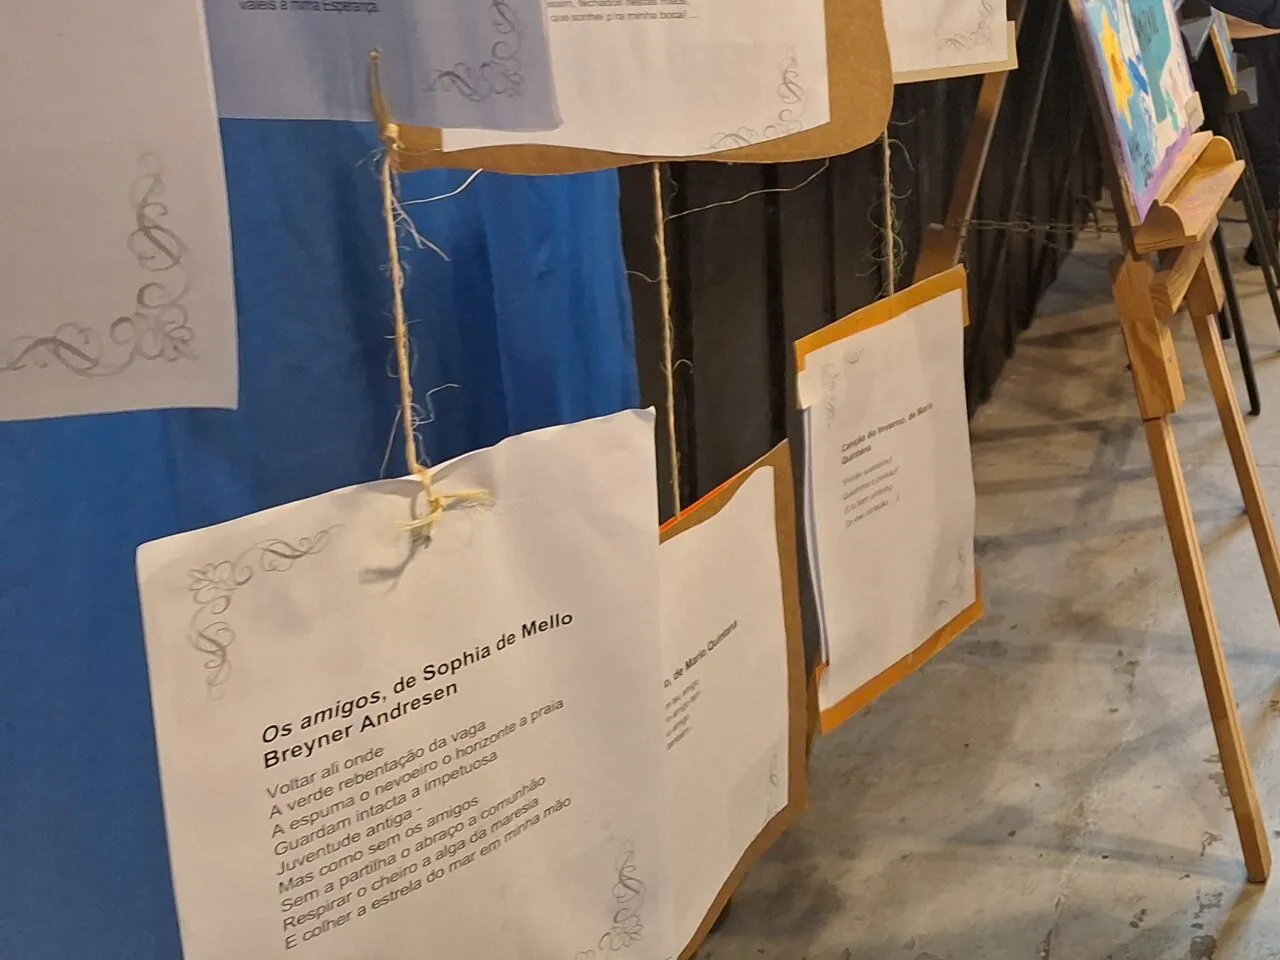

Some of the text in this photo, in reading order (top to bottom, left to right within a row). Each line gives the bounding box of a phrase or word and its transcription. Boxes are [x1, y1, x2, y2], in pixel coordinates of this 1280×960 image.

[263, 613, 572, 743] Os amigos, de Sophia de Mello
[264, 684, 457, 768] Breyner Andresen
[266, 748, 384, 798] Voltar ali onde
[269, 722, 486, 819] A verde rebentação da vaga
[272, 700, 564, 838] A espuma o nevoeiro o horizonte a praia
[274, 752, 497, 855] Guardam intacta a impetuosa
[277, 810, 412, 876] Juventude antiga
[279, 797, 479, 894] Mas como sem os amigos
[281, 777, 546, 912] Sem a partilha o abraço a comunhão
[284, 798, 539, 931] Respirar o cheiro a alga da maresia
[285, 798, 571, 950] E colher a estrela do mar em minha mão
